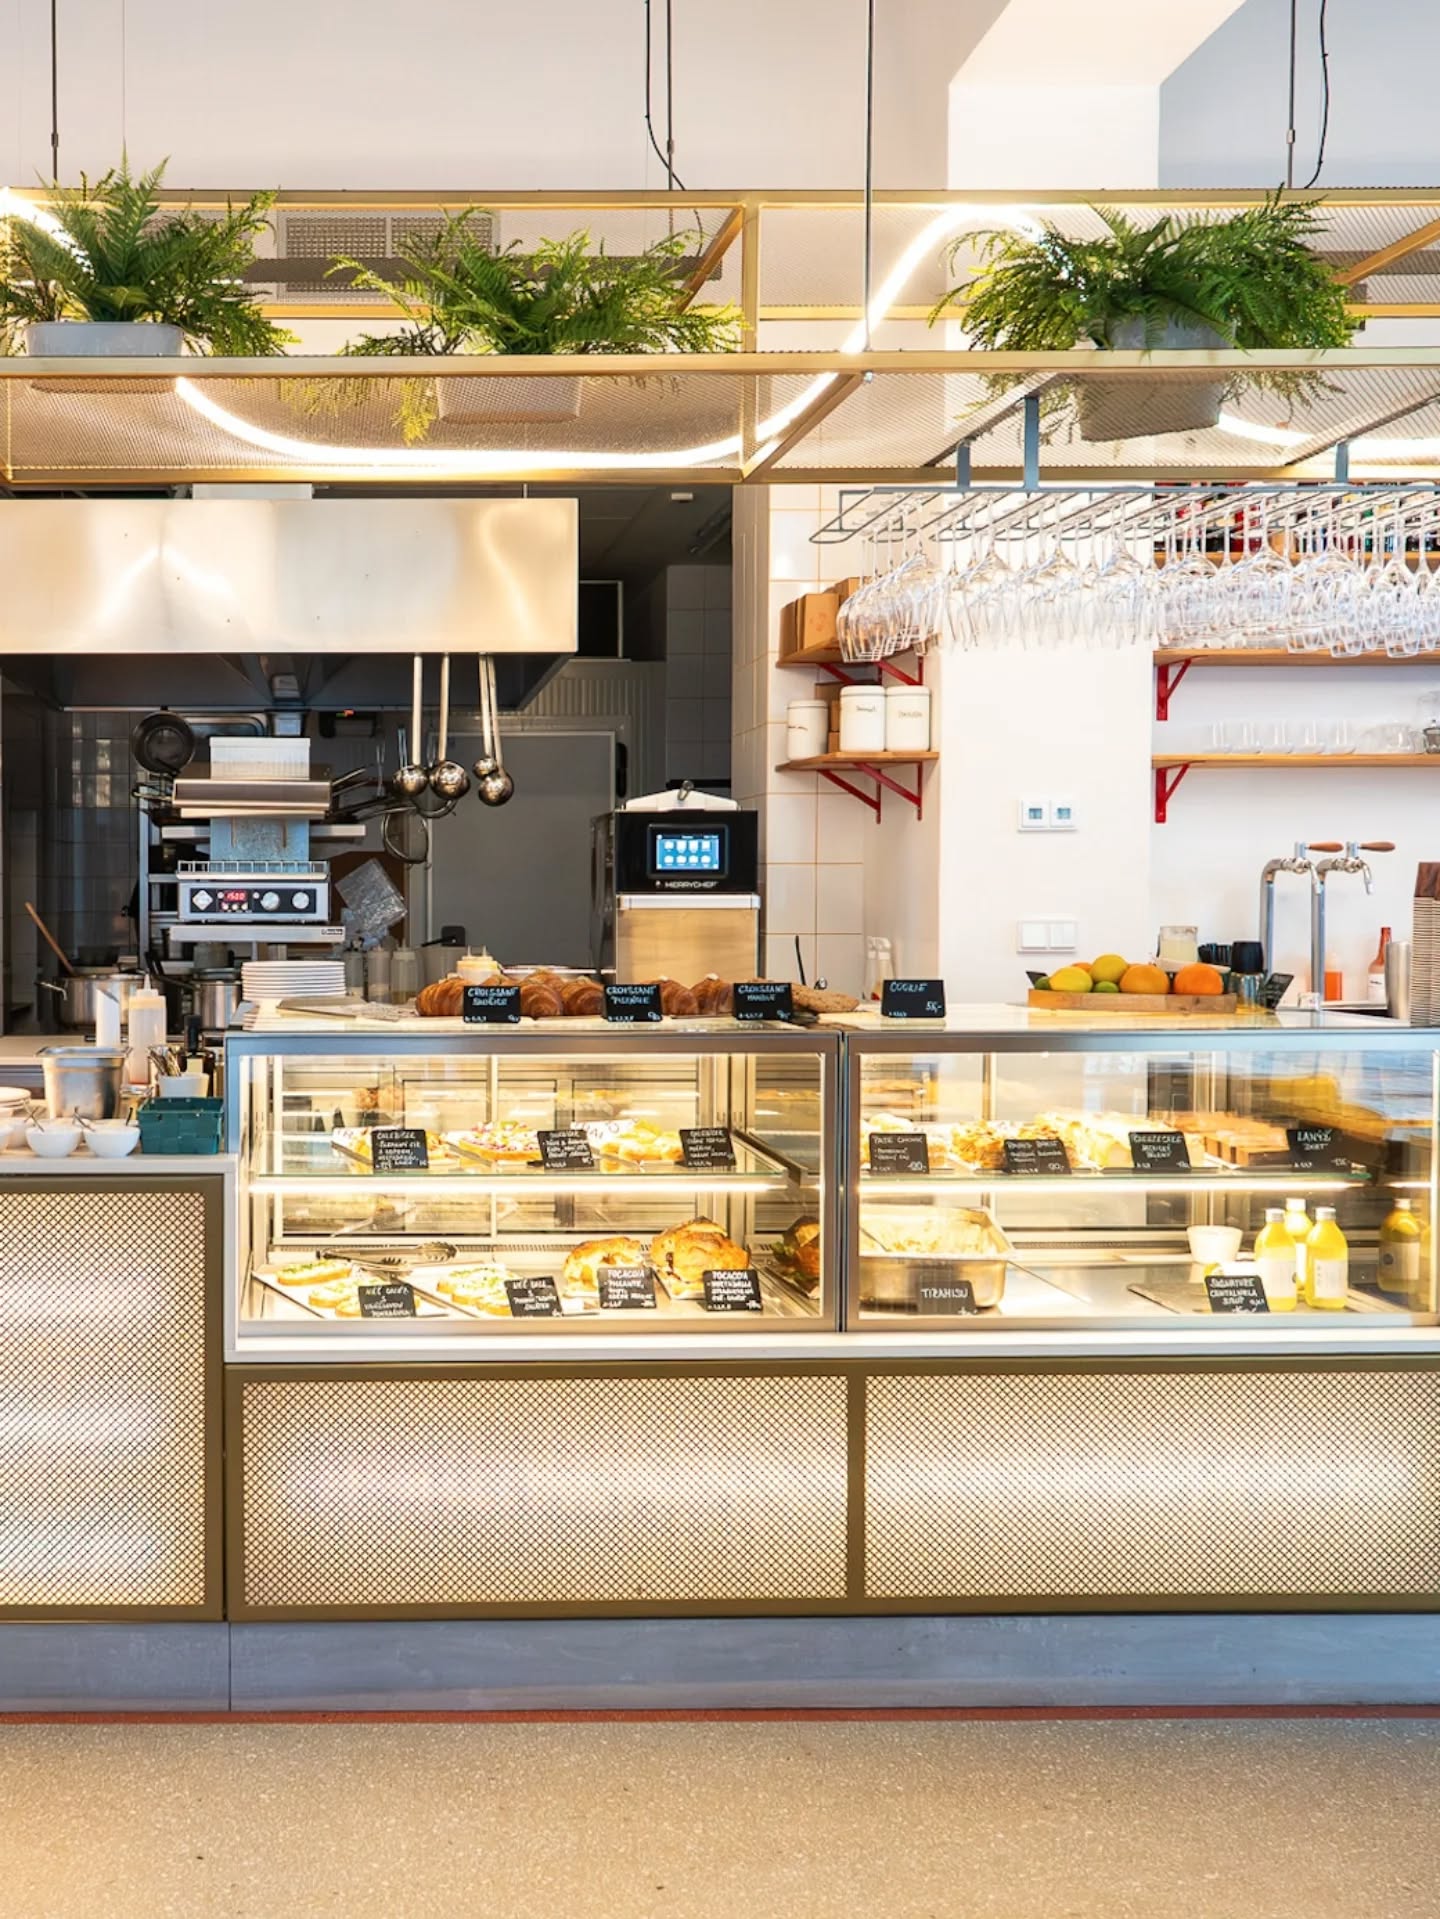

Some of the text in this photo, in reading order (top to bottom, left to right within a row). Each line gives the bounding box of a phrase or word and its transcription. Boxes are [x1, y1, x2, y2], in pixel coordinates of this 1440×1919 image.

[664, 880, 718, 889] MERRYCHEF
[467, 986, 518, 998] CROISSANT
[606, 985, 656, 995] CROISSANT
[737, 984, 789, 994] CROISSANT
[889, 981, 928, 993] COOKIE
[920, 1287, 969, 1299] TIRAMISU
